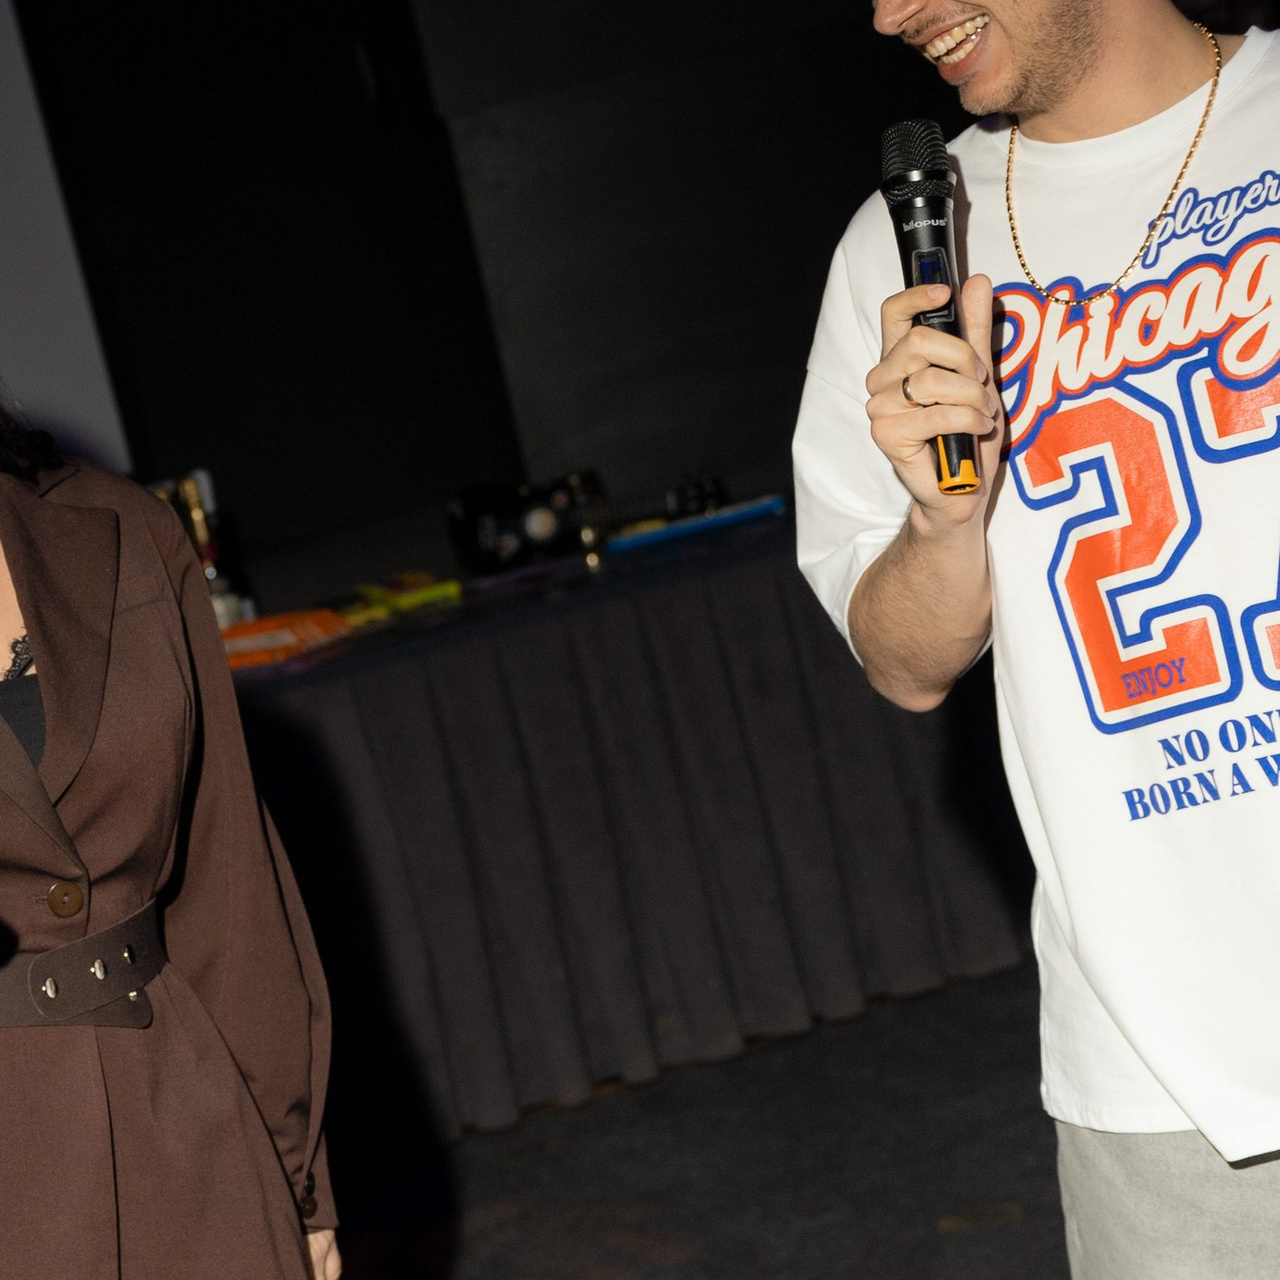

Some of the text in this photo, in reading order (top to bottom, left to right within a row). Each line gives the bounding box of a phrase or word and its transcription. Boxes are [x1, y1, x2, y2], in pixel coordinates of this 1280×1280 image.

[1122, 657, 1187, 699] ENJOY
[1158, 729, 1210, 770] NO
[1218, 709, 1280, 753] ON
[1122, 769, 1221, 821] BORN
[1230, 763, 1255, 796] A
